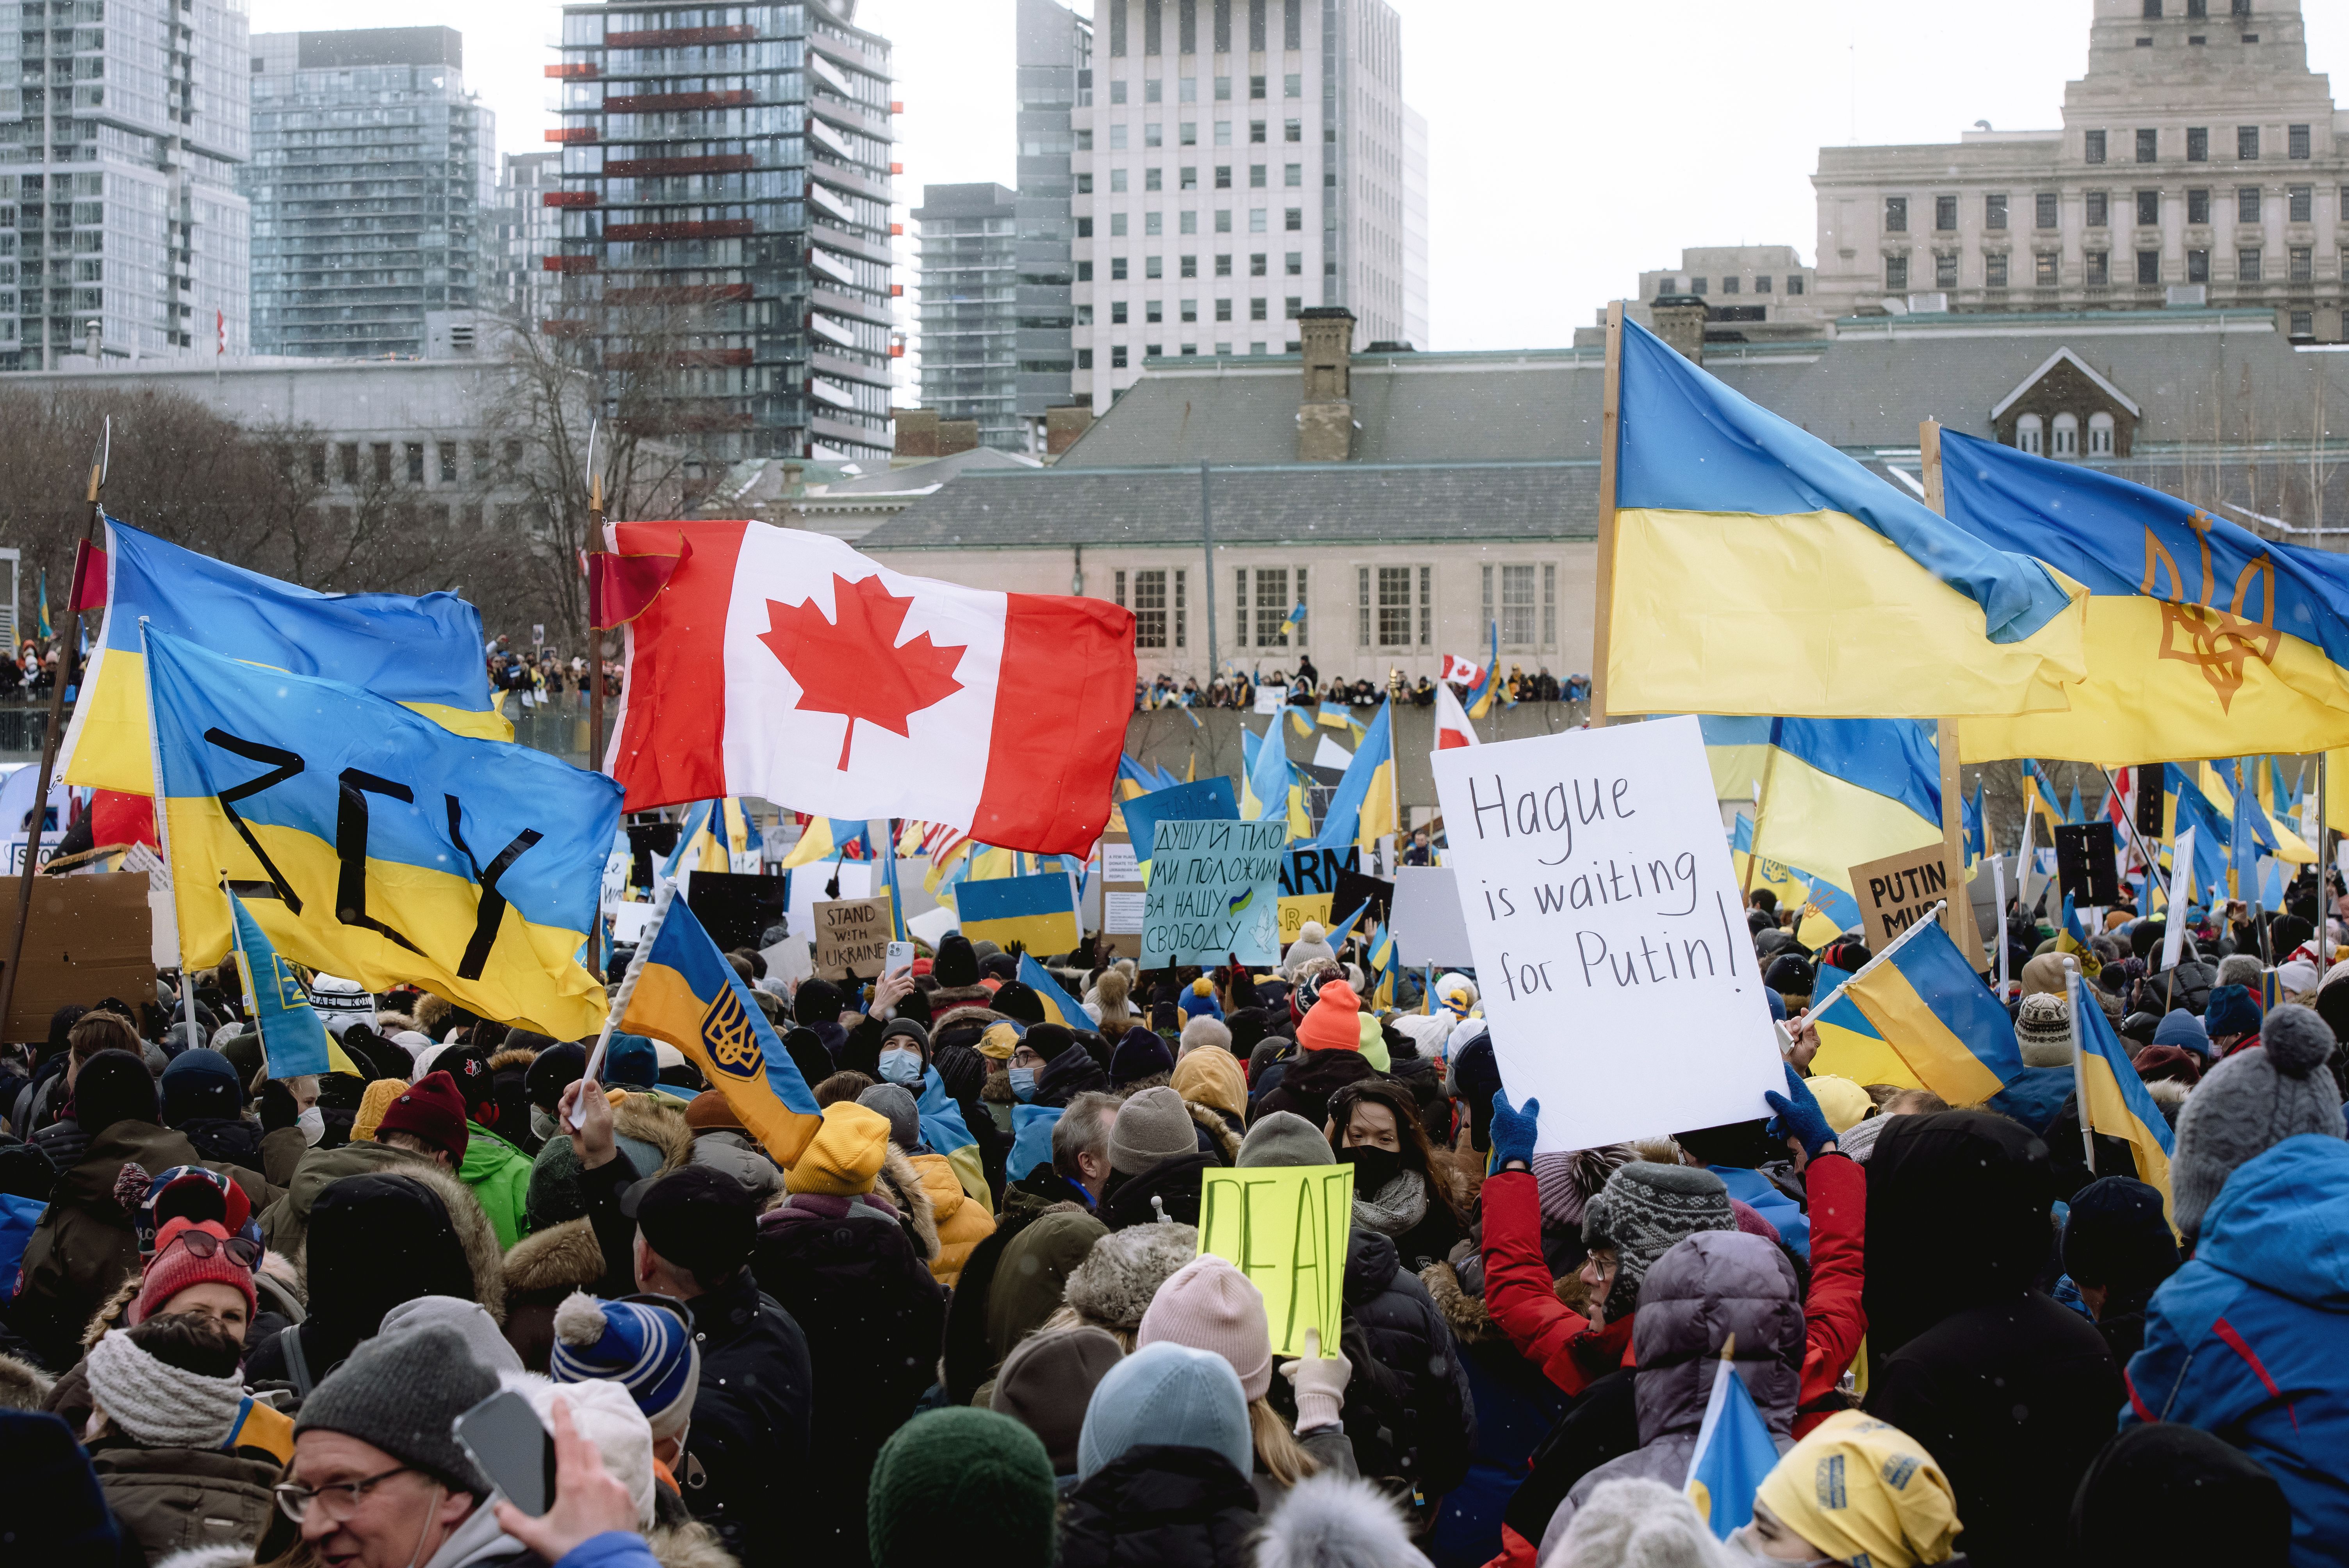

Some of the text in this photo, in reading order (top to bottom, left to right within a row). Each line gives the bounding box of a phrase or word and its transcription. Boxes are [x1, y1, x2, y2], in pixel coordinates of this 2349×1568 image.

[1469, 774, 1636, 865] Hague
[1154, 822, 1283, 852] ДУШУ Й ТІЛО
[1150, 857, 1277, 887] МИ ПОЛОЖИМ
[1482, 851, 1696, 921] is waiting
[1869, 860, 1946, 908] PUTIN
[827, 905, 875, 926] STAND
[1144, 894, 1164, 918] ЗА
[1175, 889, 1227, 918] НАШУ
[835, 929, 868, 941] WITH
[1146, 922, 1241, 953] СВОБОДУ
[1500, 891, 1741, 1001] for Putin!
[826, 943, 884, 966] UKRAINE
